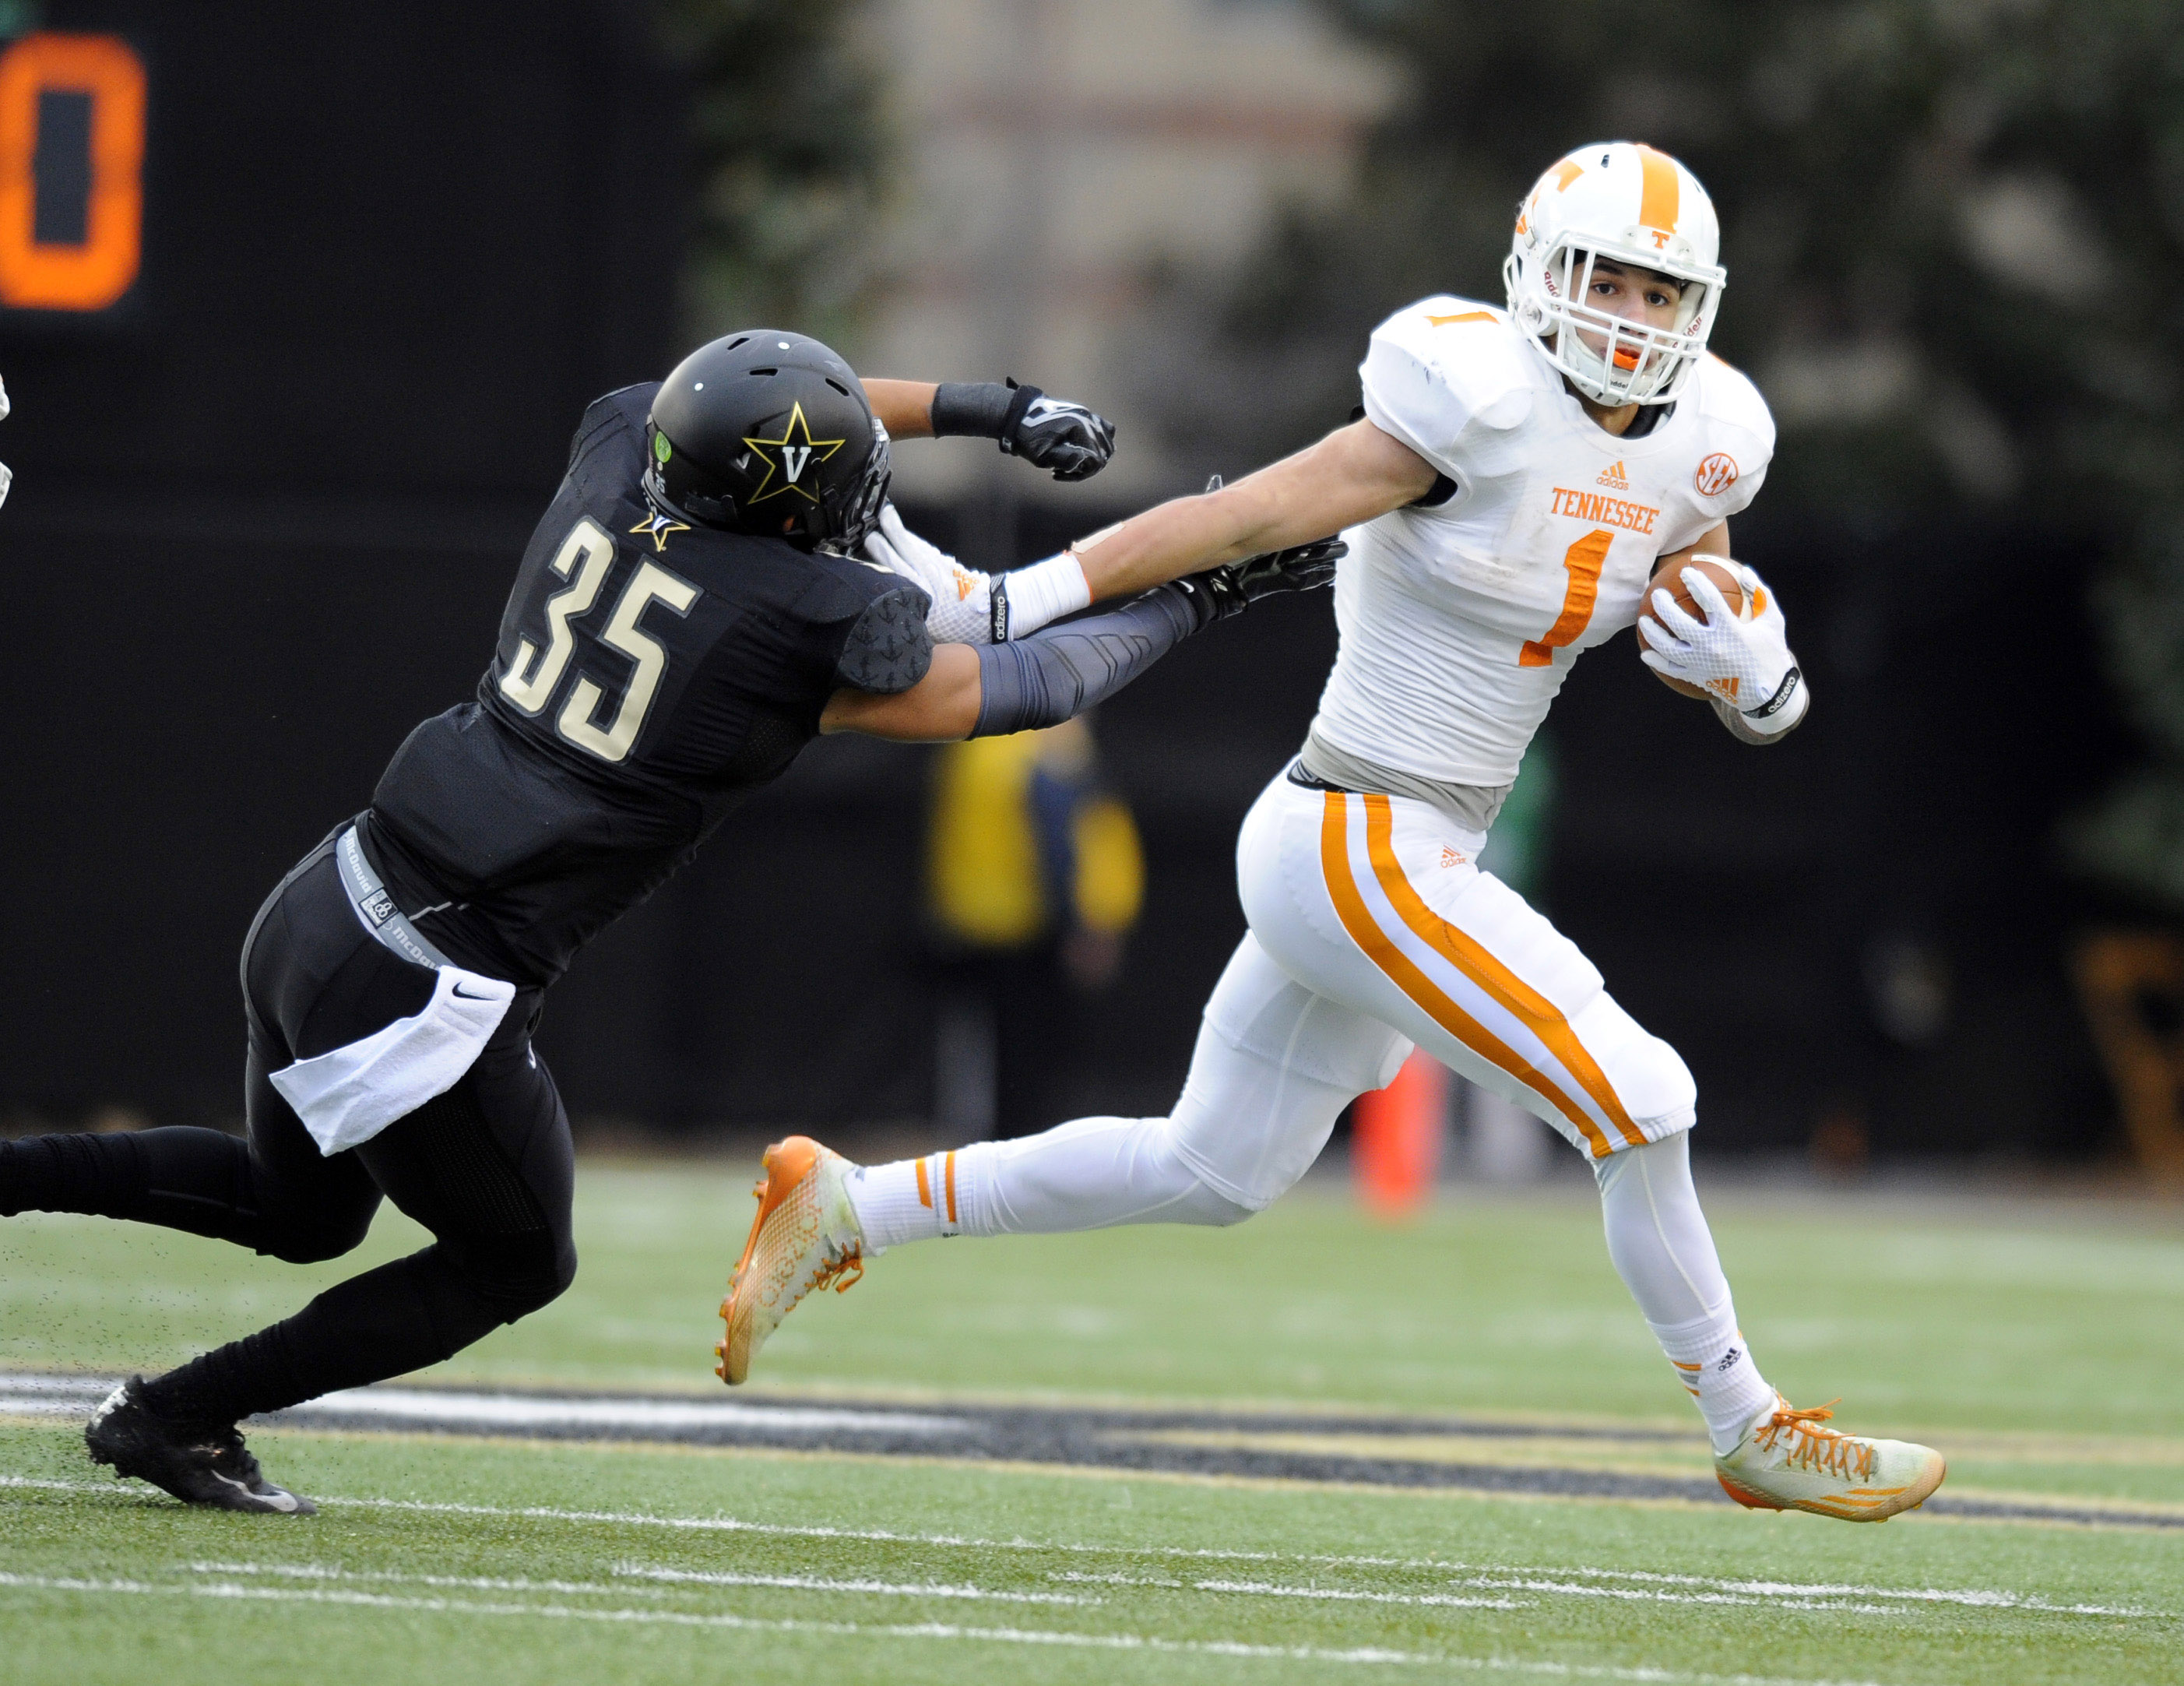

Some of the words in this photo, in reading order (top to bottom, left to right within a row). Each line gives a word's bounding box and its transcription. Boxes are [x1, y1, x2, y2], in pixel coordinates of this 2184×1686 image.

[0, 30, 148, 312] 0
[1652, 231, 1670, 249] T
[783, 446, 811, 483] V
[1596, 475, 1629, 491] adidas
[1697, 453, 1738, 496] SEC
[1551, 487, 1659, 535] TENNESSEE
[995, 596, 1005, 640] adizero
[1519, 530, 1615, 667] 1
[499, 515, 704, 758] 35
[1768, 676, 1795, 713] adizero
